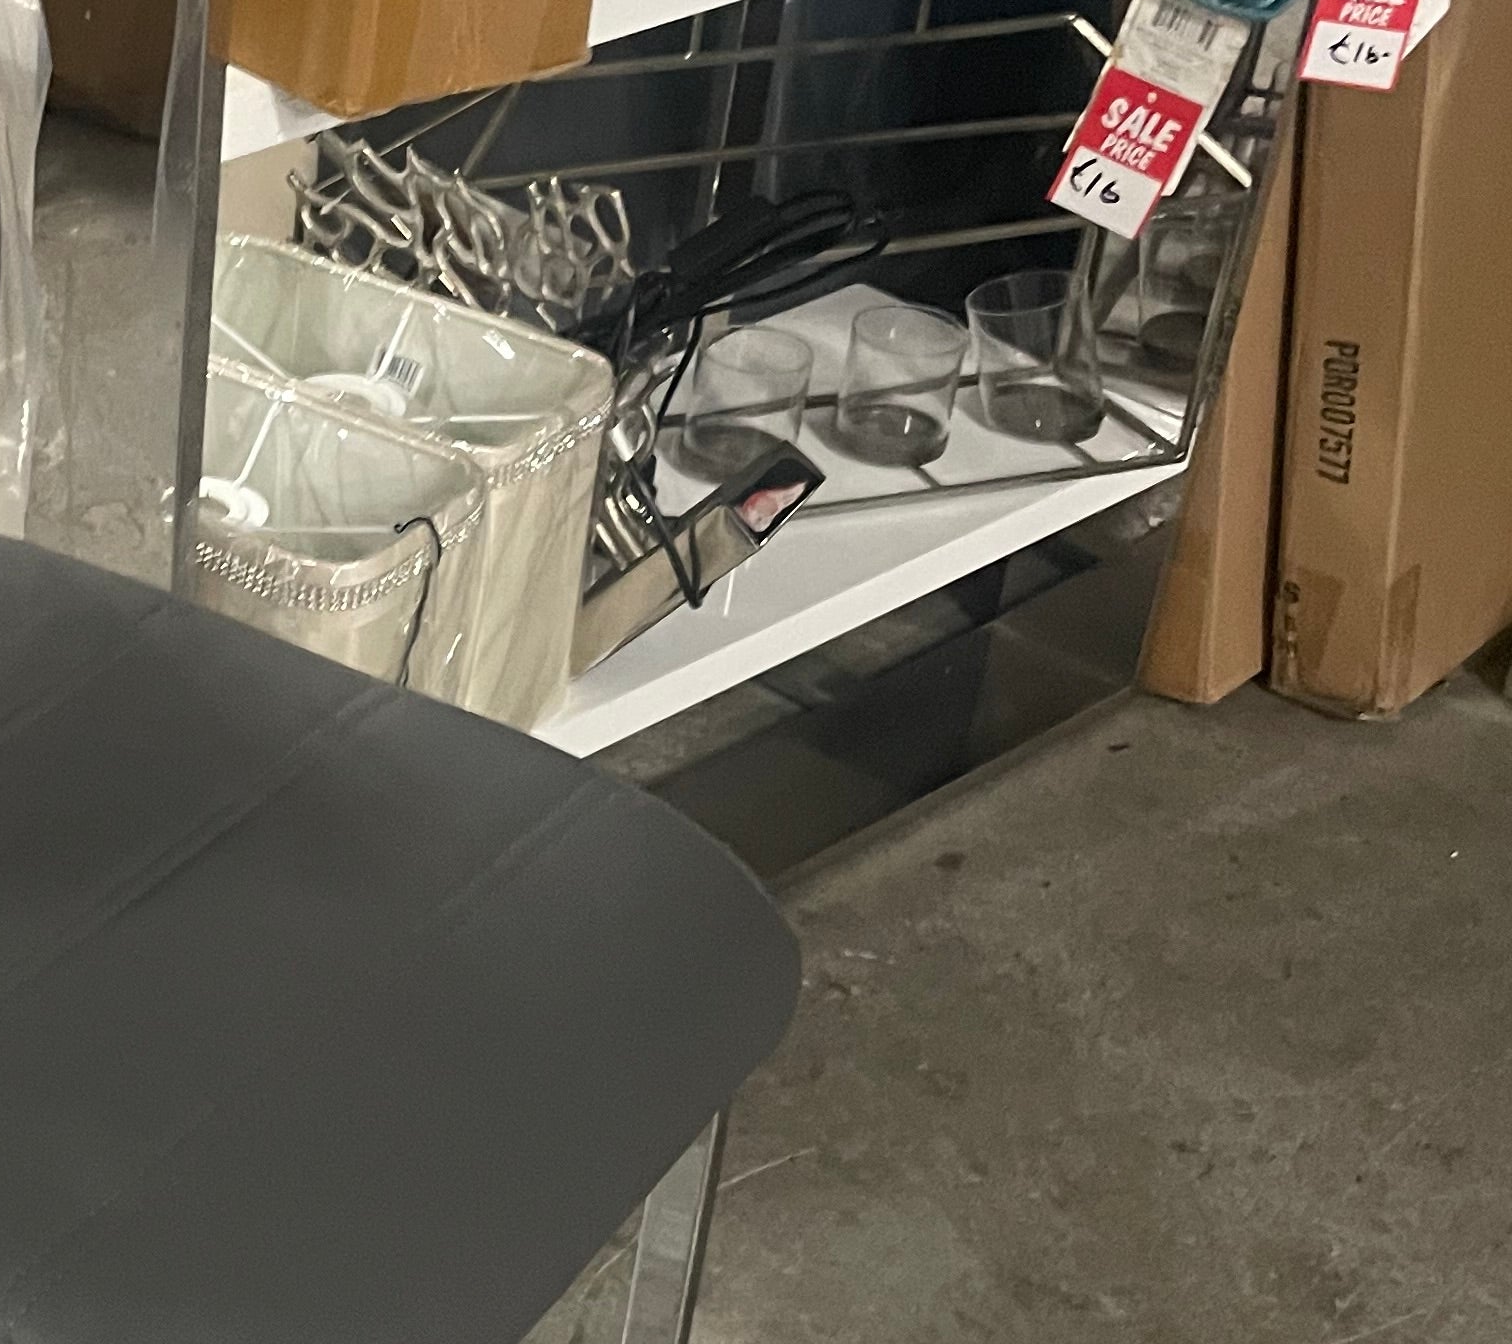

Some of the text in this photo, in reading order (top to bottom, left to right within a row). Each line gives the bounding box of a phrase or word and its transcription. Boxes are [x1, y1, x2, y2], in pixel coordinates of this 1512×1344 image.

[1339, 2, 1393, 27] PRICE
[1100, 97, 1182, 153] SALE
[1099, 133, 1158, 171] PRICE
